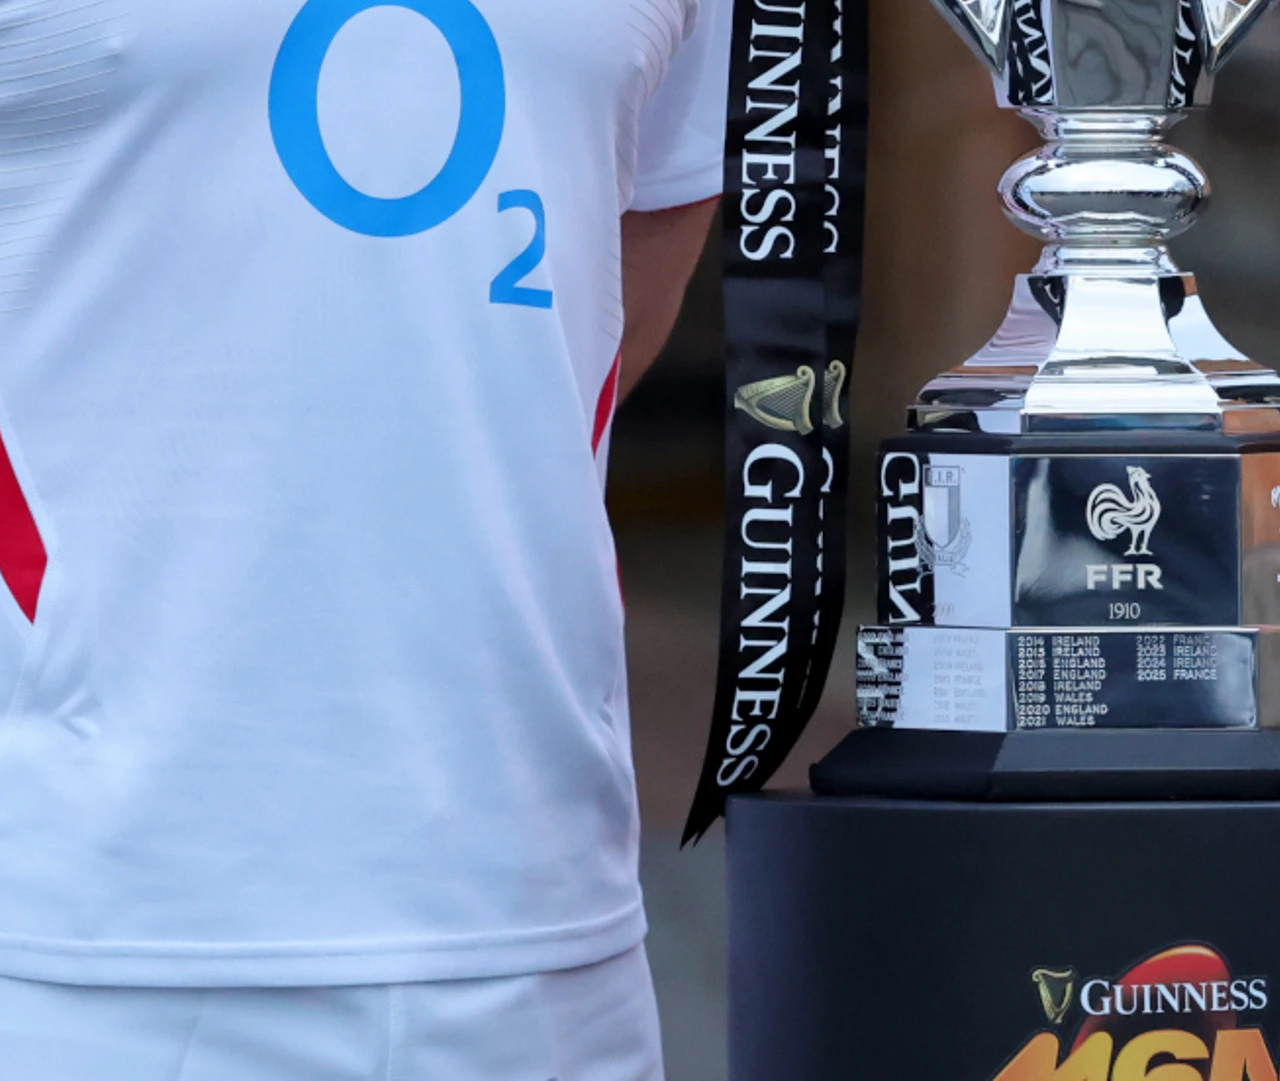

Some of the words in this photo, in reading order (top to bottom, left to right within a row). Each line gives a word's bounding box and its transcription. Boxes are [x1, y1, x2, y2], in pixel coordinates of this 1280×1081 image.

[1085, 563, 1164, 590] FFR
[716, 443, 805, 787] GUINNESS
[1108, 602, 1141, 620] 1910
[1018, 635, 1045, 647] 2014
[1051, 635, 1100, 647] IRELAND
[1018, 647, 1046, 658] 2015
[1051, 647, 1100, 658] IRELAND
[1173, 645, 1217, 657] IRELAND
[1053, 658, 1106, 669] ENGLAND
[1136, 657, 1167, 669] 2024
[1173, 658, 1217, 669] IRELAND
[1018, 669, 1046, 680] 2017
[1053, 669, 1106, 680] ENGLAND
[1136, 669, 1167, 681] 2025
[1173, 669, 1218, 680] FRANCE
[1018, 681, 1047, 692] 2018
[1053, 681, 1102, 692] IRELAND
[1018, 693, 1047, 703] 2019
[1054, 693, 1094, 703] WALES
[1019, 704, 1051, 715] 2020
[1055, 704, 1109, 715] ENGLAND
[1018, 716, 1047, 727] 2021
[1055, 716, 1096, 727] WALES
[1080, 979, 1269, 1015] GUINNESS
